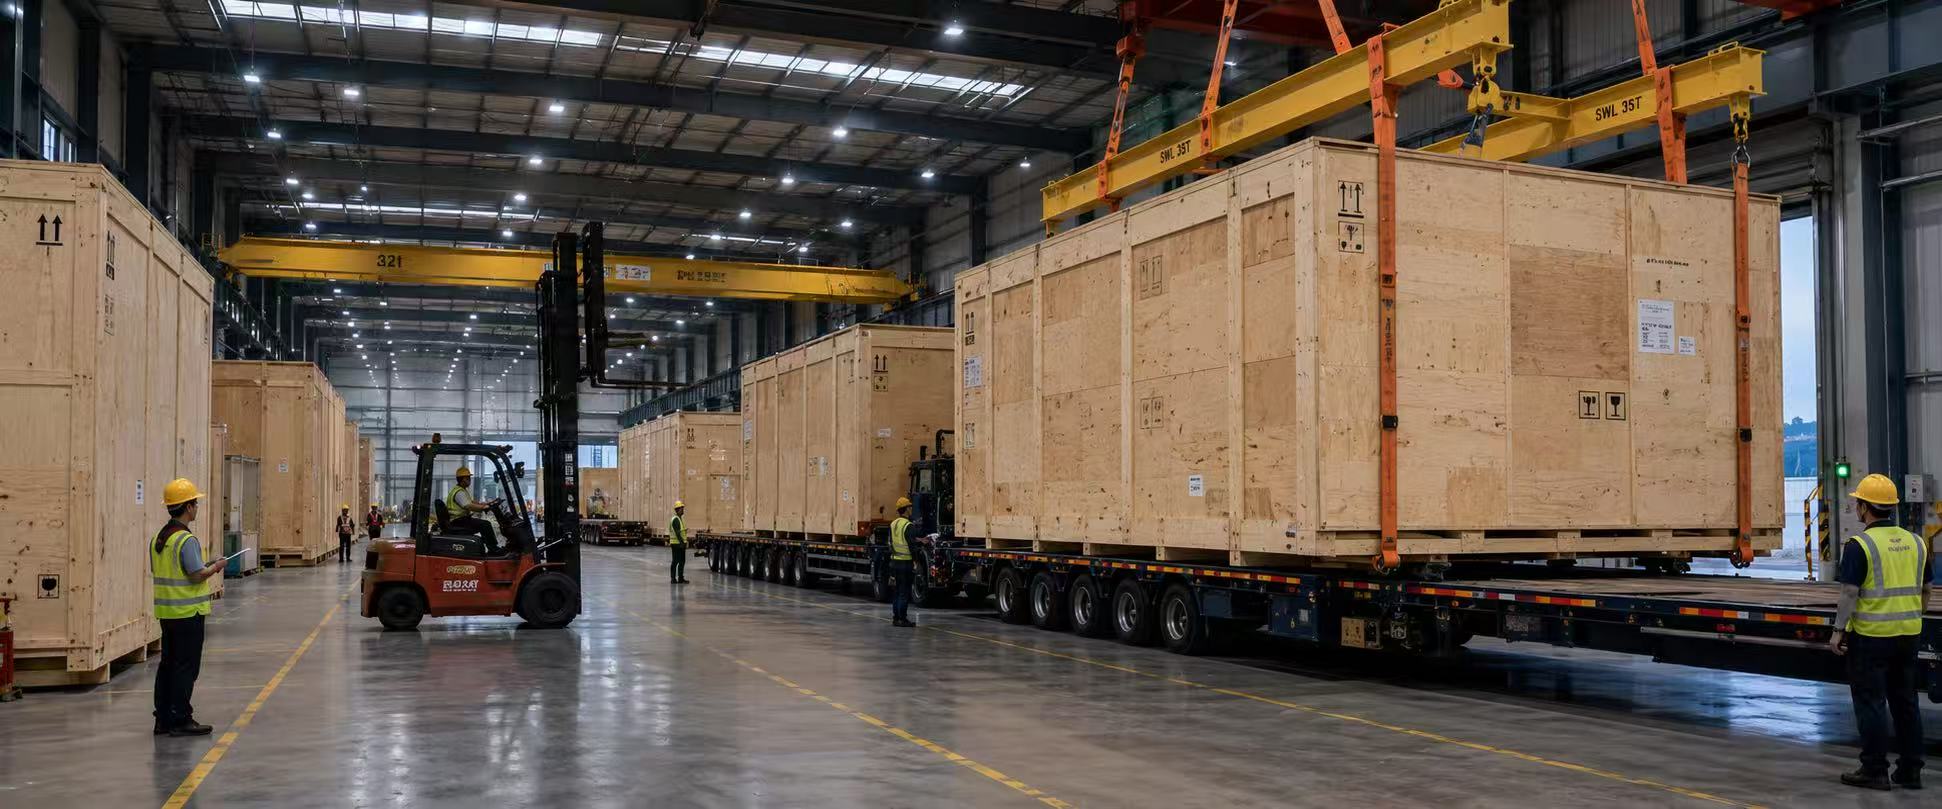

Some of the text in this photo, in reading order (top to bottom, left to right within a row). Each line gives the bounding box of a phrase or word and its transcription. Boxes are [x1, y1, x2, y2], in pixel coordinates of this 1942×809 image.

[1595, 96, 1642, 120] SWL 35T
[1160, 140, 1191, 163] SWL 35T
